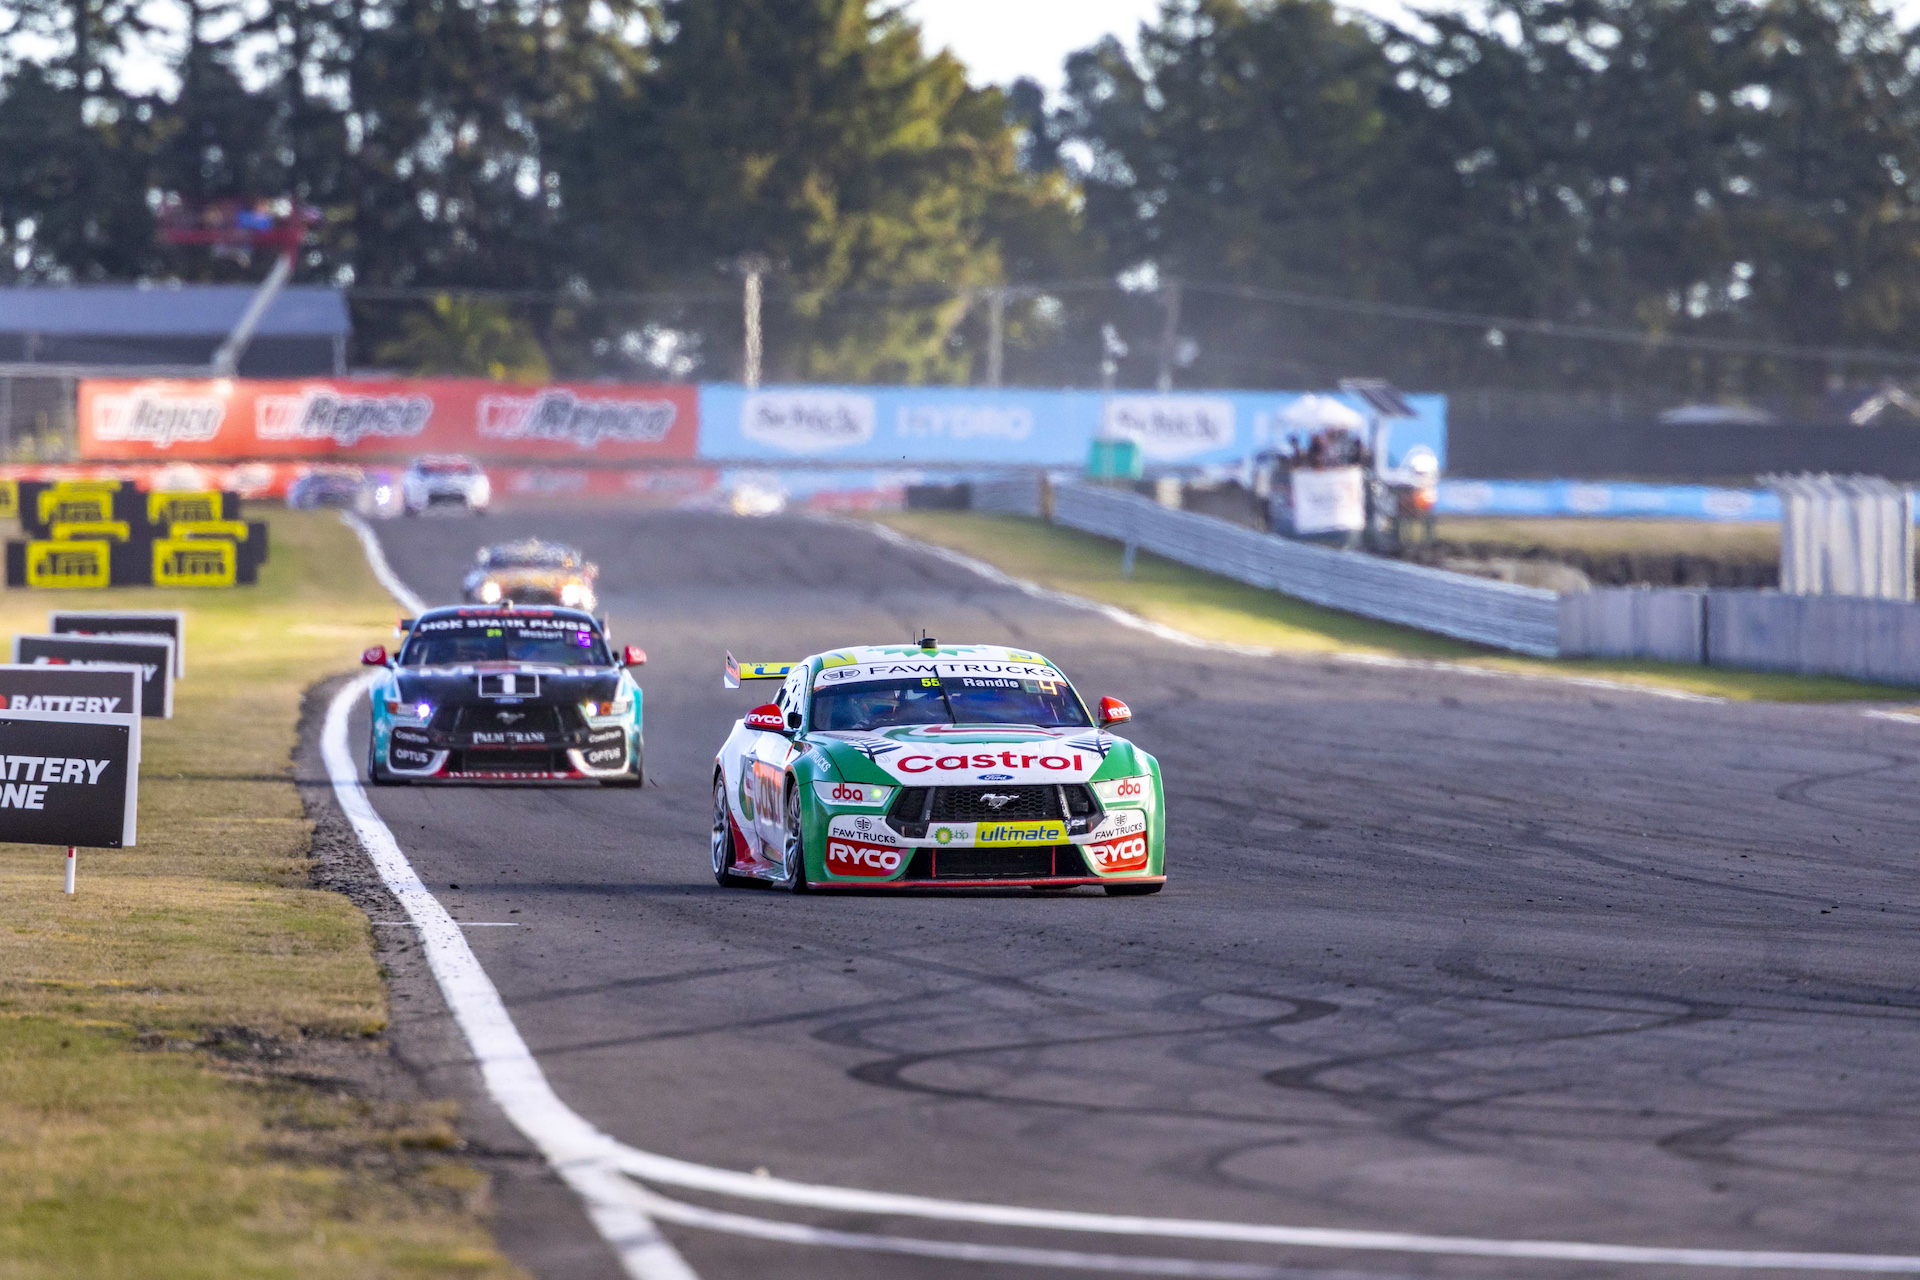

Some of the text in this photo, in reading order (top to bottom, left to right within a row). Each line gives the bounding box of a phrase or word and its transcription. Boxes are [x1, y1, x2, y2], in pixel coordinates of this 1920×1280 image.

[466, 618, 526, 629] SPARK
[529, 618, 592, 632] PLUGS
[869, 664, 1056, 678] FAW TRUCKS
[921, 677, 1020, 689] 55 Randle
[10, 695, 121, 714] BATTERY
[747, 713, 784, 725] RYCO
[396, 749, 429, 763] OPTUS
[588, 747, 621, 763] OPTUS
[897, 751, 1083, 774] Castrol
[0, 783, 49, 810] NE
[832, 783, 863, 801] dba
[1117, 779, 1141, 797] dba
[832, 827, 897, 844] FAW TRUCKS
[956, 825, 1060, 842] bp ultimate
[1094, 822, 1143, 840] FAW TRUCKS
[829, 842, 901, 870] RYCO
[1090, 838, 1146, 863] RYCO
